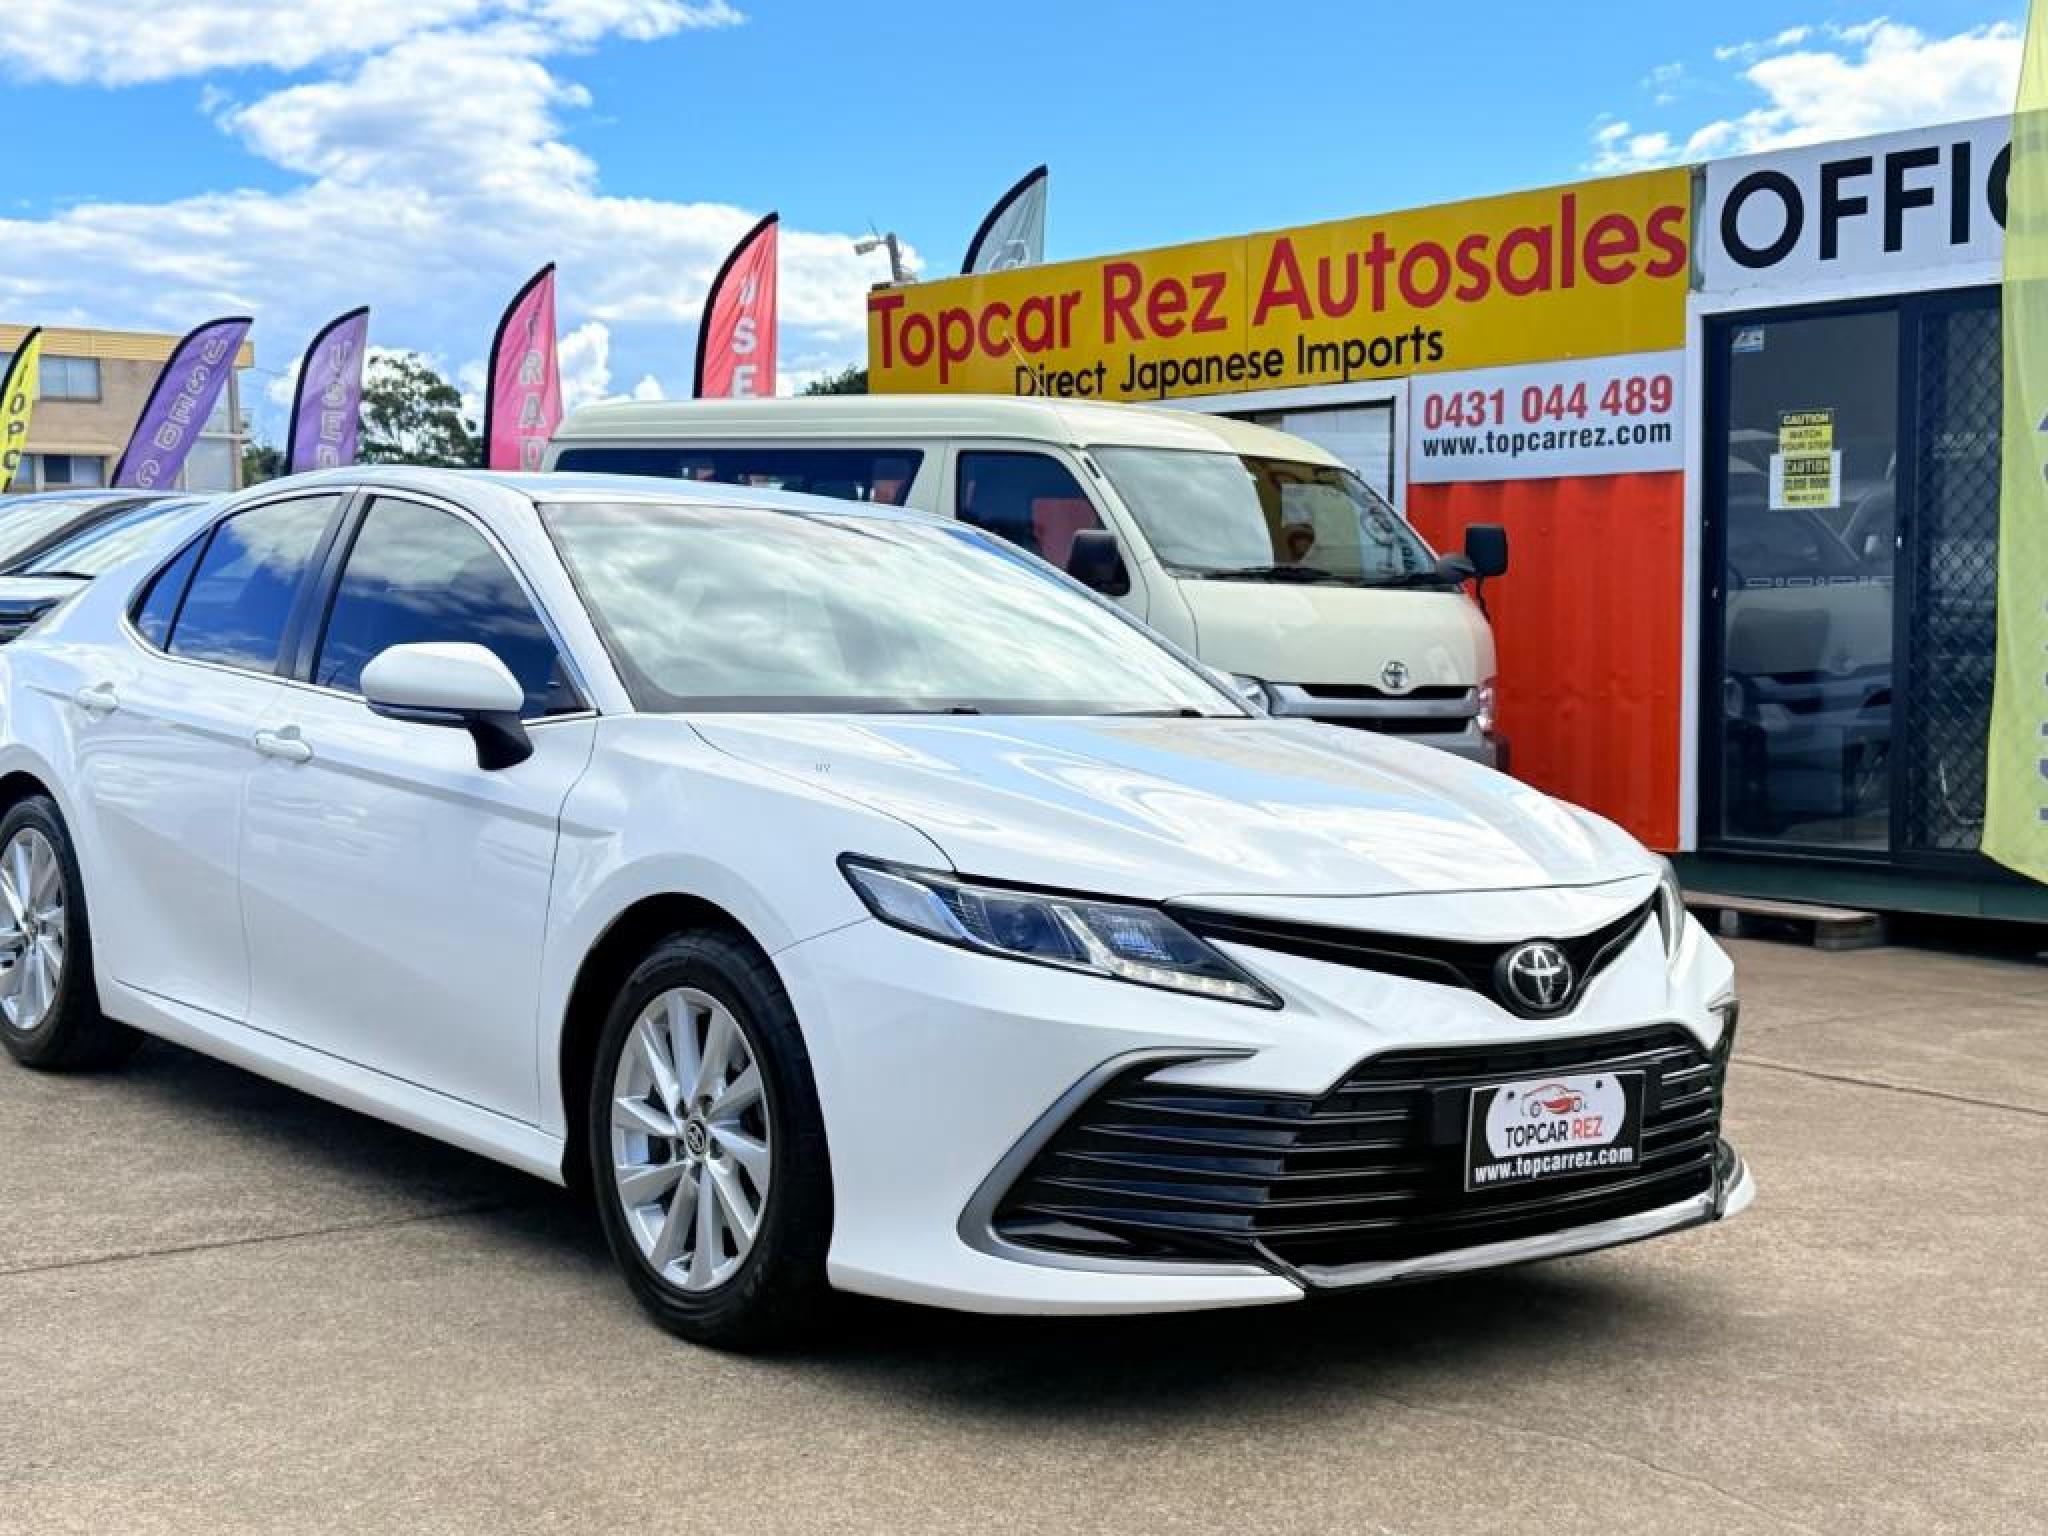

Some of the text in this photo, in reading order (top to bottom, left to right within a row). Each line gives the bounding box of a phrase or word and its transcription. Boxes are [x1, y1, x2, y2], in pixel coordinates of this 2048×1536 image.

[867, 192, 1687, 385] Topcar Rez Autosales
[1015, 324, 1443, 399] Direct Japanese Imports
[1424, 373, 1674, 431] 0431 044 489
[1423, 421, 1673, 458] www.topcarrez.com
[1504, 1115, 1603, 1149] TOPCAR REZ
[1475, 1147, 1634, 1183] www.topcarrez.com
